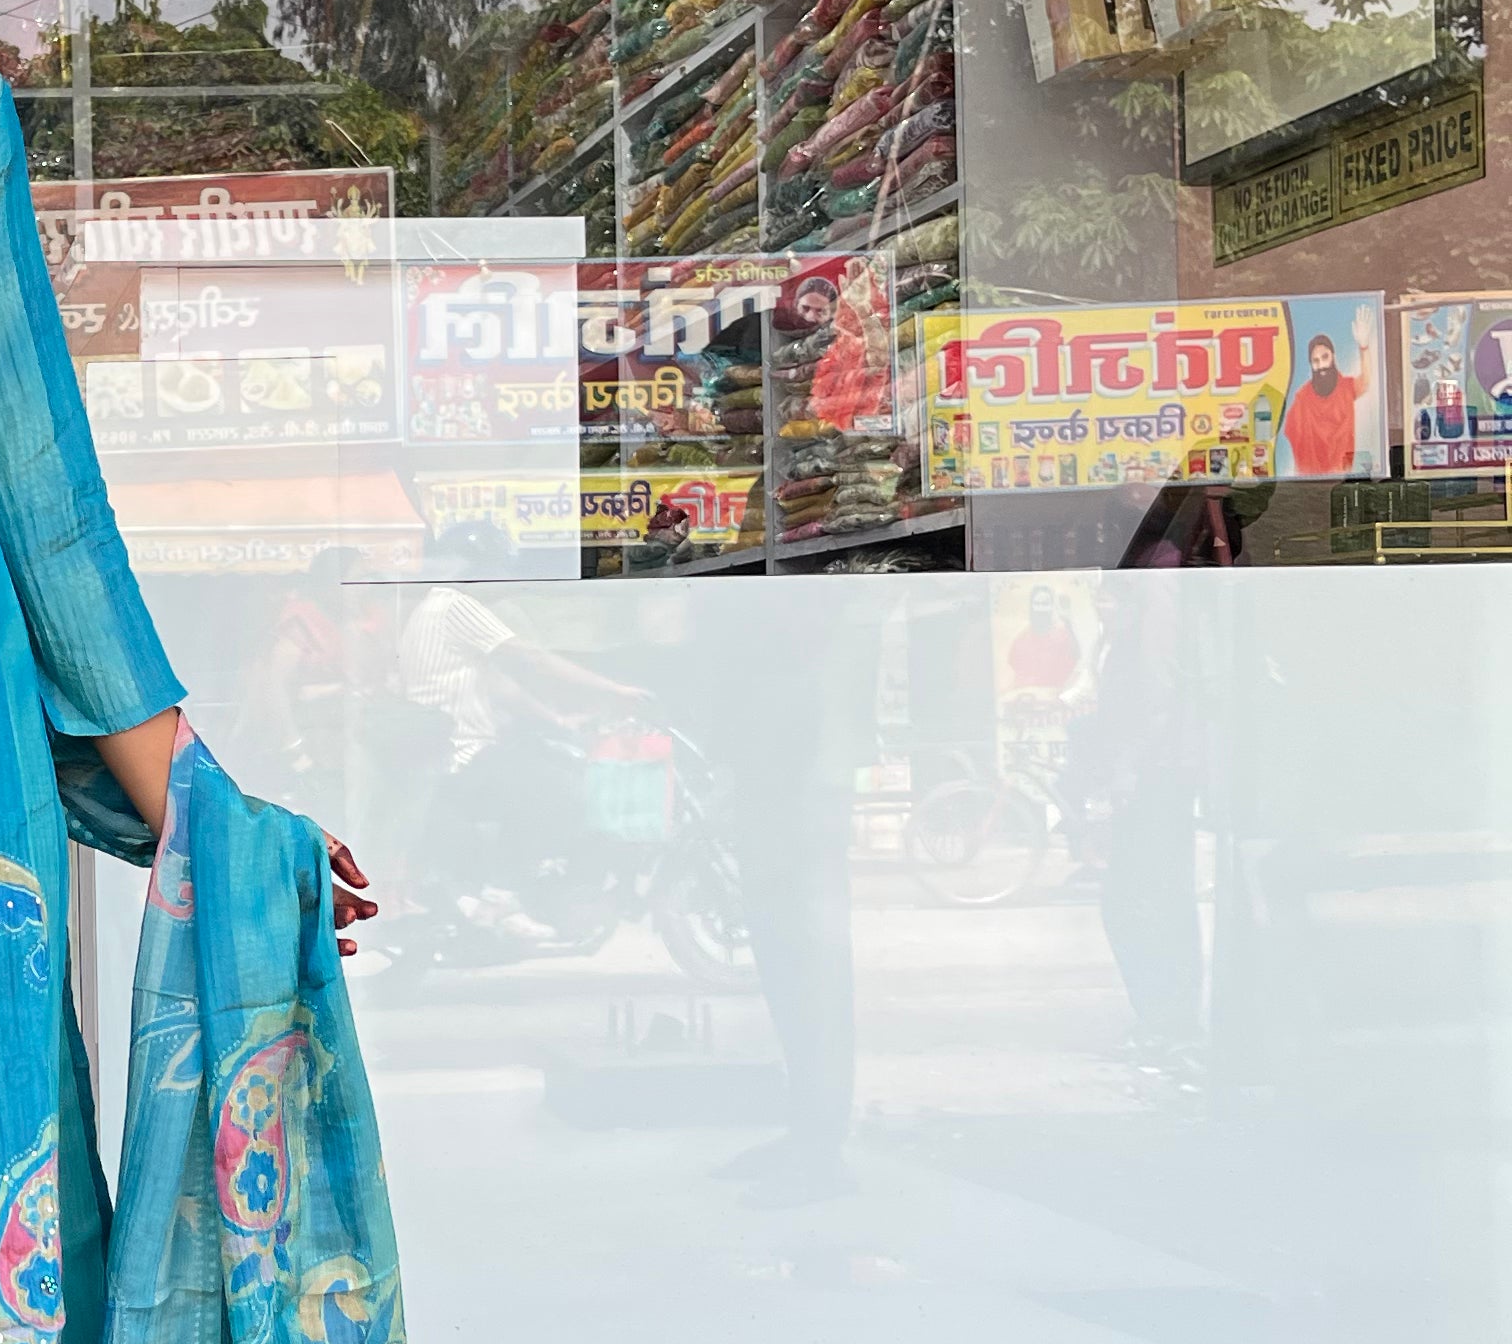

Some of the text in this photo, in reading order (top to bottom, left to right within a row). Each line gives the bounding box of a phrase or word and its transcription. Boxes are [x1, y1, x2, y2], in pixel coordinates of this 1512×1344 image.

[1343, 110, 1473, 195] FIXED PRICE
[1234, 162, 1310, 214] NO RETURN
[1255, 188, 1330, 236] EXCHANGE
